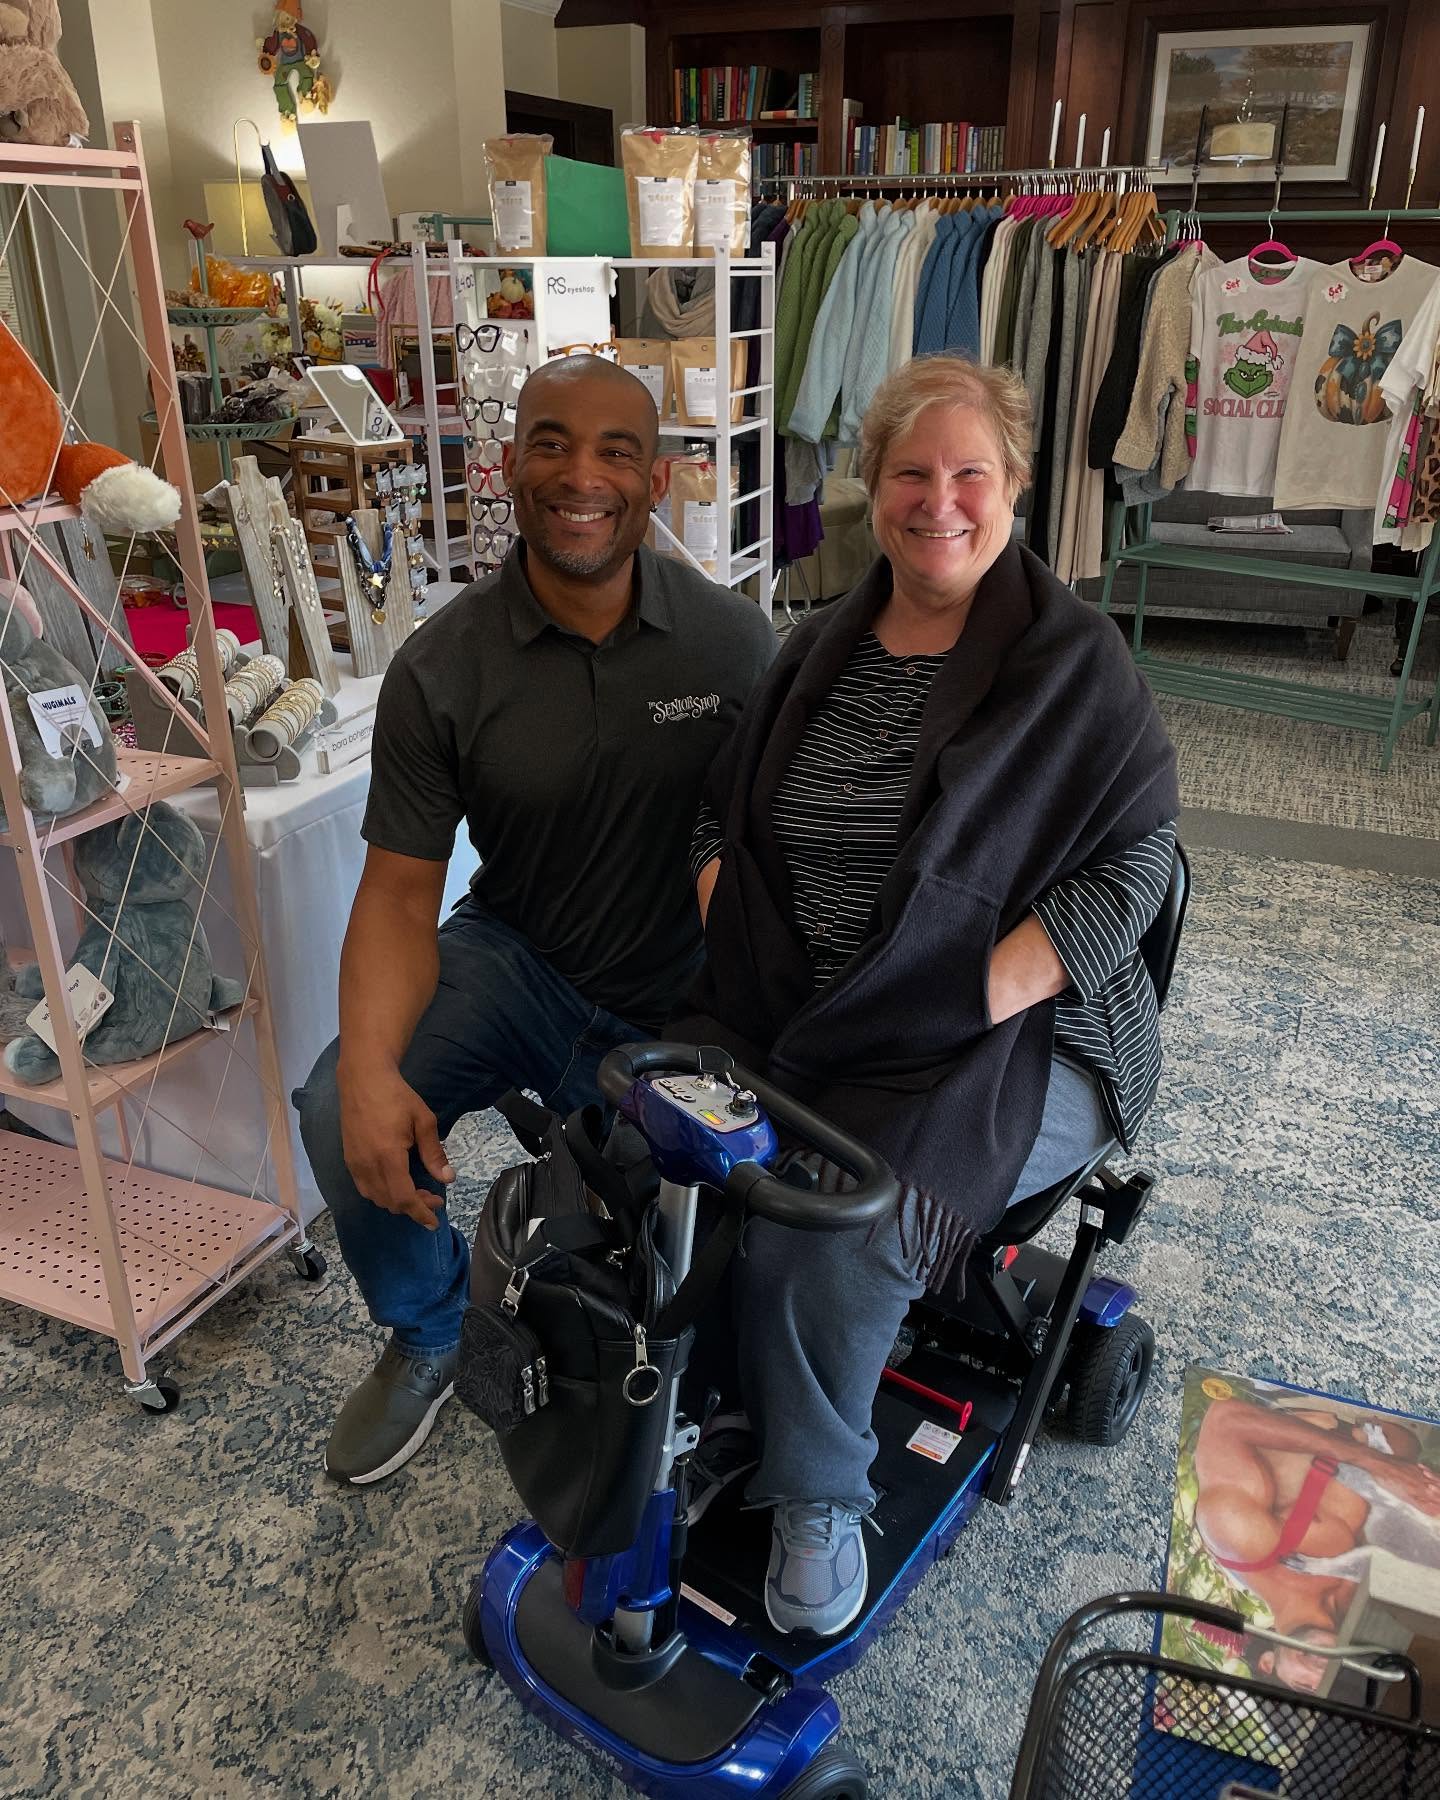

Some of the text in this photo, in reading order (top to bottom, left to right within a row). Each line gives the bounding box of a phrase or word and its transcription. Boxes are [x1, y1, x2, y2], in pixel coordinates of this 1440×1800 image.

[547, 277, 595, 295] RS eyeshop
[1226, 279, 1240, 290] Set
[1328, 283, 1343, 296] Set
[1203, 397, 1286, 418] SOCIAL CL
[42, 696, 77, 710] HUGIMALS
